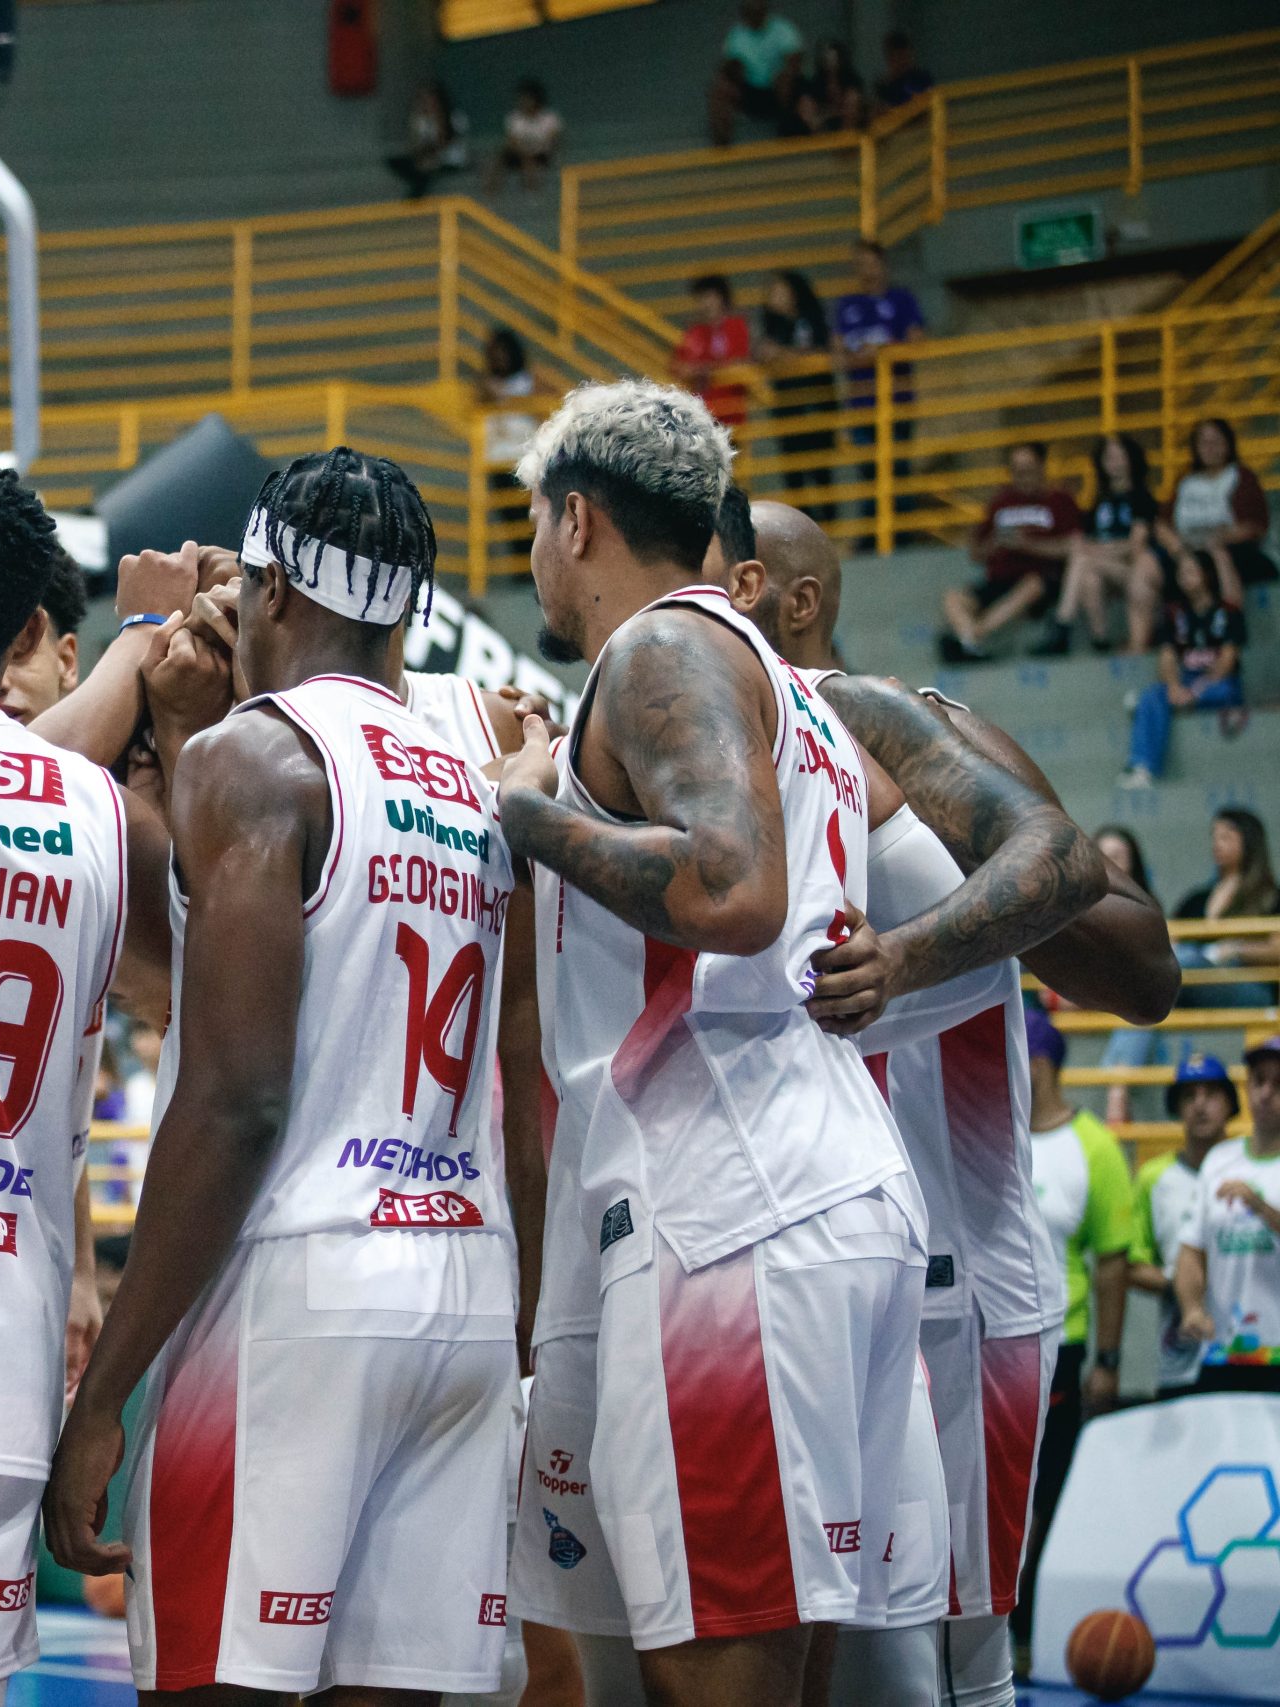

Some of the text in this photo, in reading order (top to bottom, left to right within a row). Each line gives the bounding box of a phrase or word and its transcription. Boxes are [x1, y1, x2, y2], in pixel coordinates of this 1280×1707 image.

[381, 735, 470, 802] SESI
[385, 799, 490, 865] Unimed
[368, 853, 510, 936] GEORGINHO
[395, 921, 486, 1139] 14
[377, 1194, 466, 1223] FIESP
[537, 1469, 588, 1496] Topper
[267, 1596, 334, 1621] FIES
